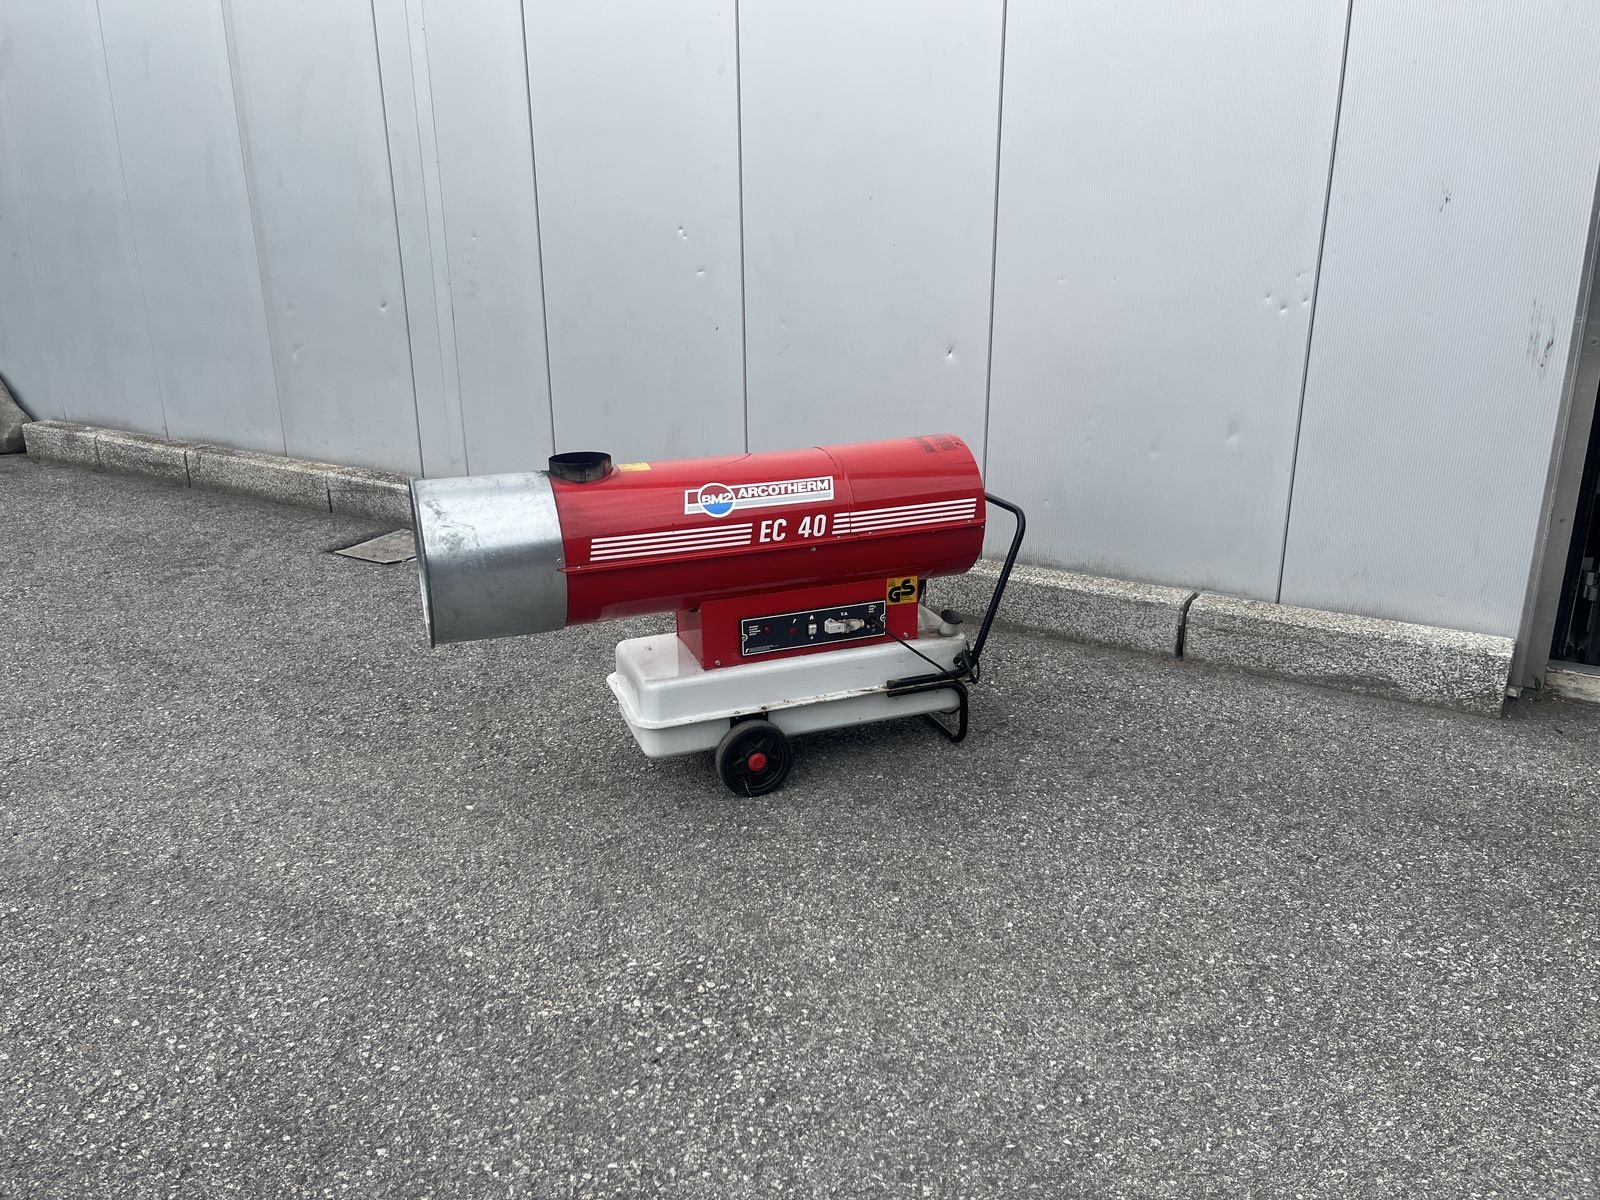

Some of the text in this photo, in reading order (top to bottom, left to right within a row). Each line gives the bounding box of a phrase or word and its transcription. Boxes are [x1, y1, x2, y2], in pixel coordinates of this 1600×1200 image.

[701, 479, 830, 505] BM2 ARCOTHERM
[759, 514, 827, 543] EC 40
[888, 578, 916, 603] GS
